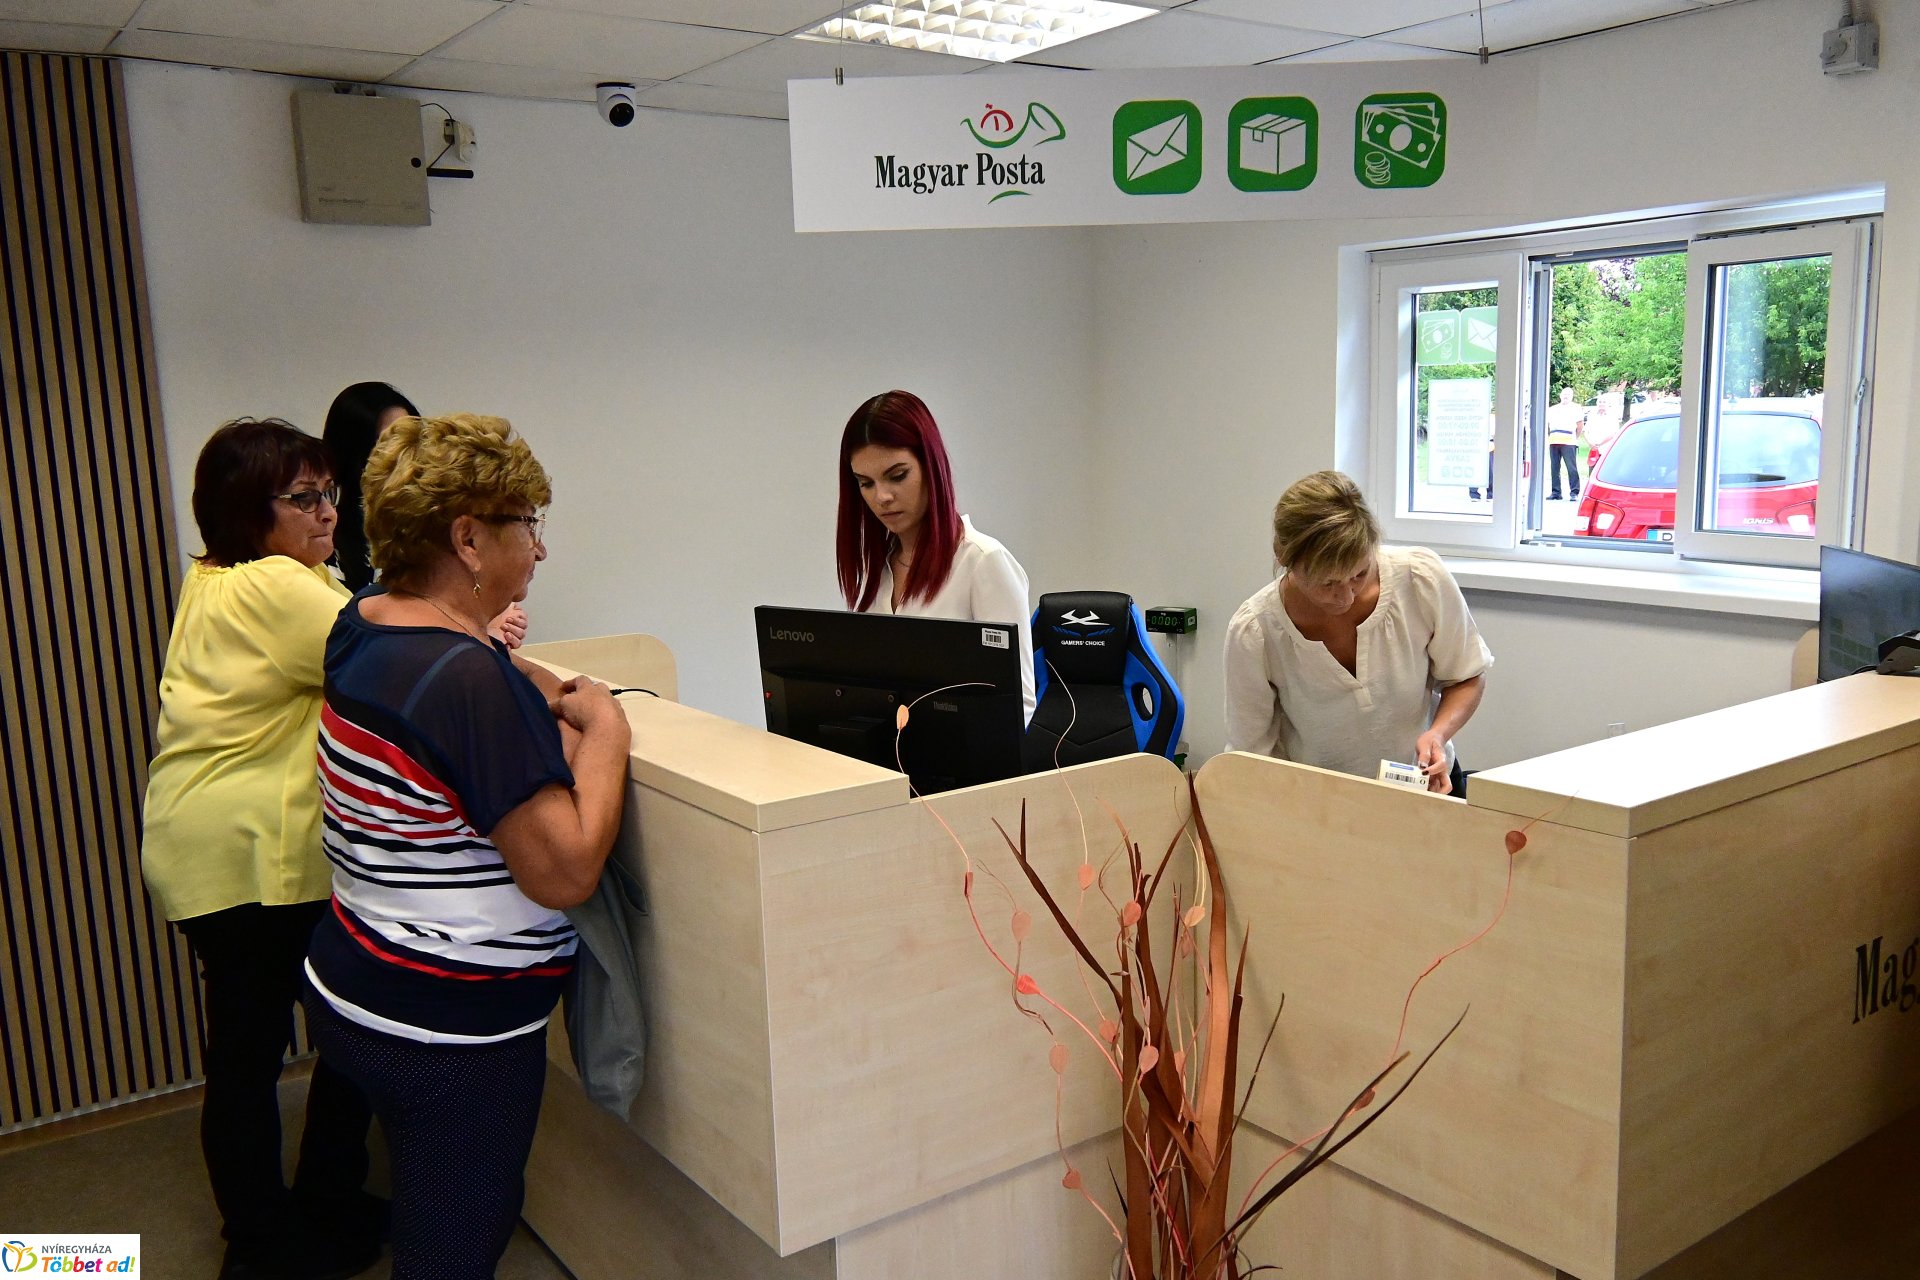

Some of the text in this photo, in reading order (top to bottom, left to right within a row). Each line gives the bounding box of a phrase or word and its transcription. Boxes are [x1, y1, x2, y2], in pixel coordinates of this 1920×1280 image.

[874, 152, 1046, 194] Magyar Posta
[769, 626, 815, 643] Lenovo
[1852, 936, 1920, 1025] Mag
